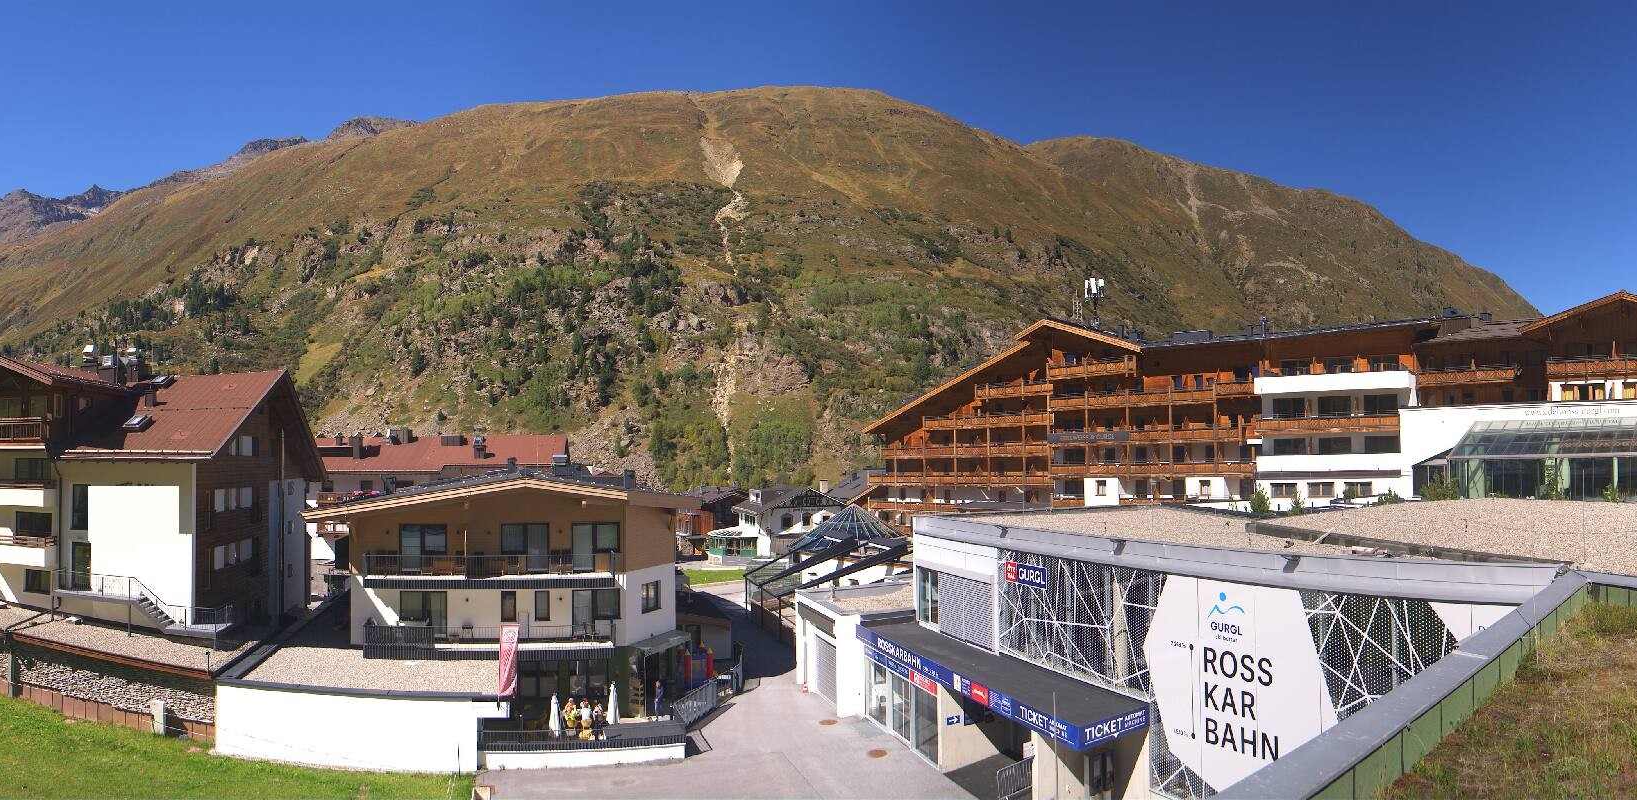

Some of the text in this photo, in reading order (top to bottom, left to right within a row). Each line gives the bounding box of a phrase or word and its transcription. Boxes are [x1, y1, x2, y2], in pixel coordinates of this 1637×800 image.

[1018, 567, 1046, 585] GURGL
[1210, 621, 1243, 636] GURGL
[877, 637, 922, 670] ROSSKARBAHN
[1203, 646, 1274, 687] ROSS
[1204, 681, 1257, 721] KAR
[1019, 705, 1049, 729] TICKET
[1084, 717, 1124, 741] TICKET
[1205, 717, 1280, 763] BAHN
